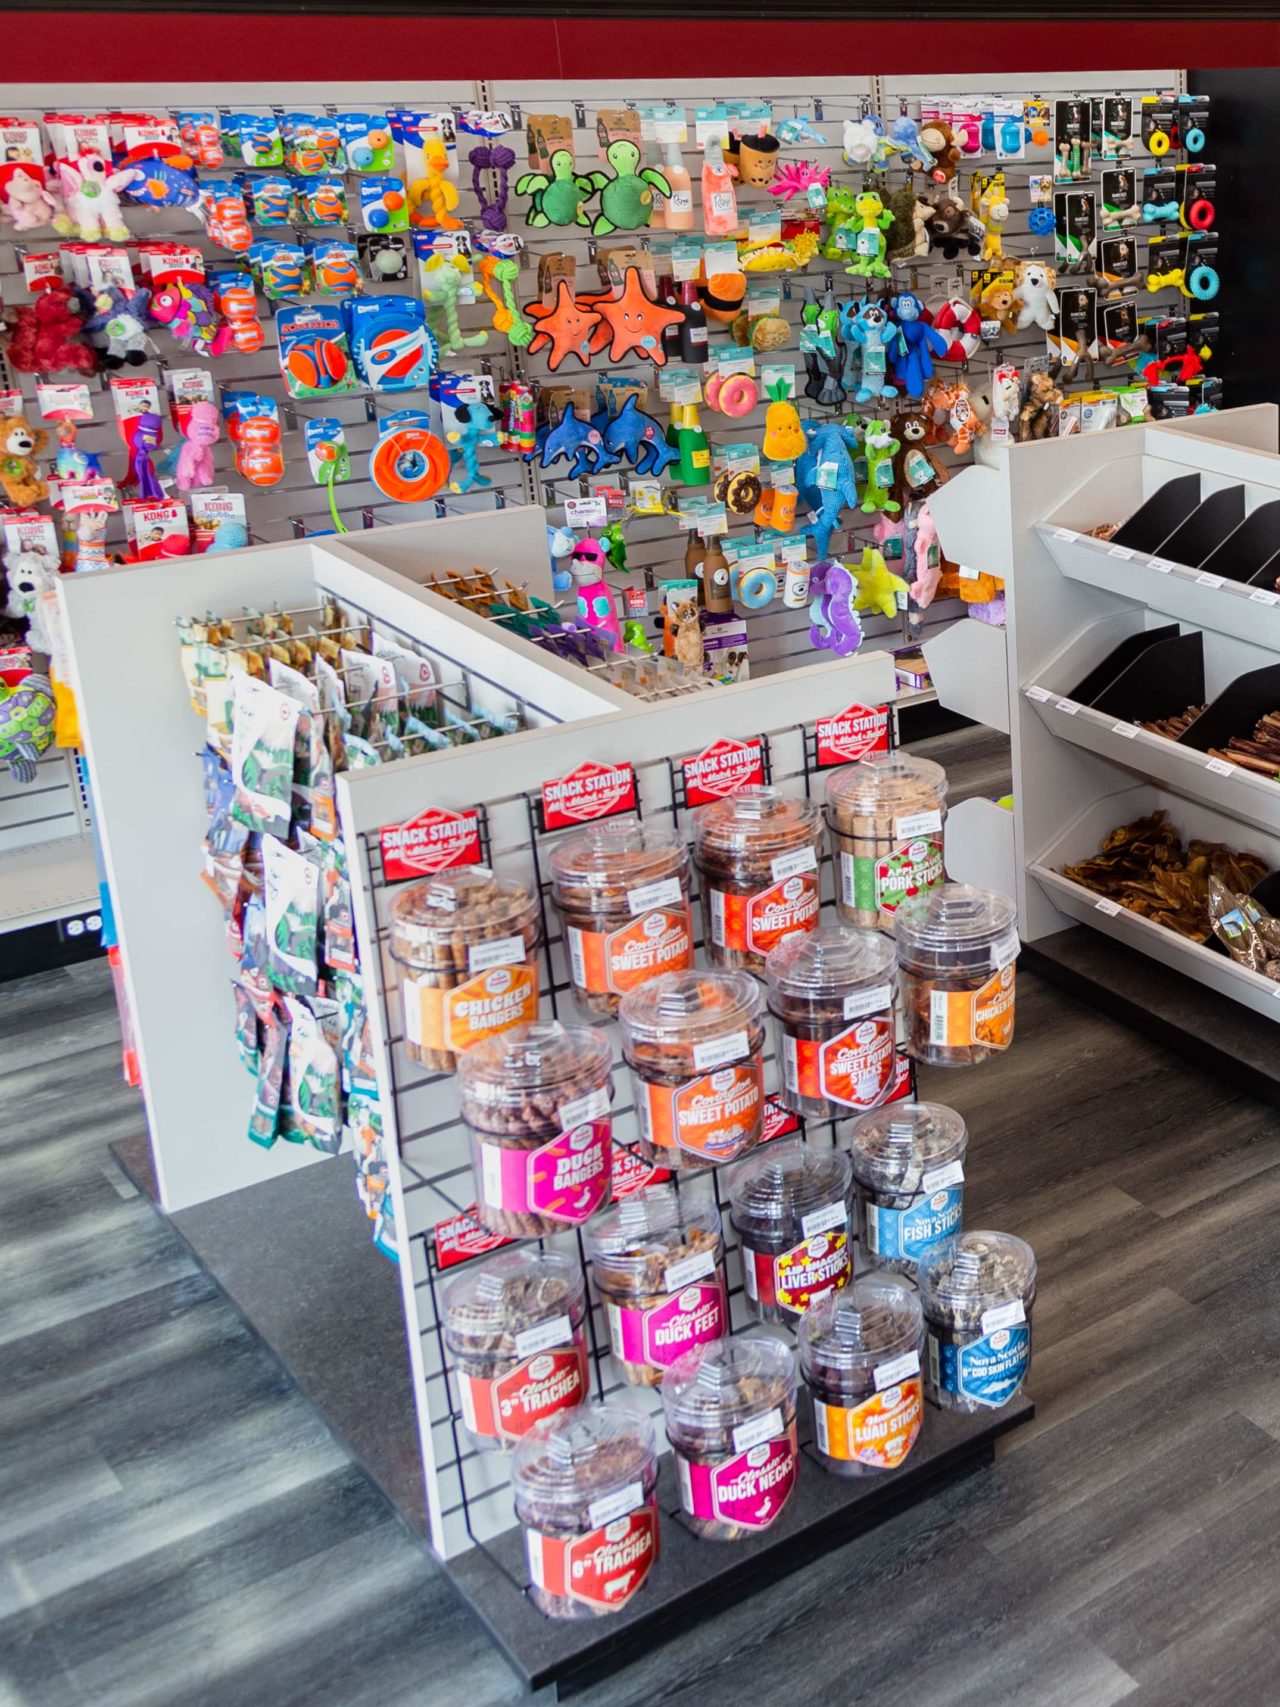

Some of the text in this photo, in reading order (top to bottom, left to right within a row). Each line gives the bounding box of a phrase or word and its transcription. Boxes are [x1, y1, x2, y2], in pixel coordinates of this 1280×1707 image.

[138, 129, 160, 137] KONG
[163, 257, 184, 265] KONG
[143, 511, 170, 521] KONG
[204, 502, 234, 512] KONG
[17, 525, 44, 535] KONG
[818, 711, 888, 737] SNACK STATION
[684, 745, 761, 777] SNACK STATION
[545, 768, 631, 801] SNACK STATION
[383, 817, 477, 848] SNACK STATION
[881, 861, 944, 892] PORK STICKS
[753, 898, 819, 931] SWEET POTATO
[611, 935, 689, 971] SWEET POTATO
[624, 925, 683, 952] Covington
[454, 982, 532, 1018] CHICKEN
[976, 1000, 1007, 1022] CHICKEN
[468, 1003, 524, 1031] BANGERS
[830, 1041, 893, 1075] SWEET POTATO
[850, 1065, 882, 1085] STICKS
[678, 1105, 723, 1126] SWEET
[725, 1086, 759, 1118] POTATO
[691, 1077, 752, 1107] Covington
[556, 1141, 603, 1175] DUCK
[553, 1158, 604, 1191] BANGERS
[904, 1205, 962, 1242] FISH STICKS
[781, 1252, 848, 1289] LIVER STICKS
[786, 1265, 804, 1276] LIP
[655, 1307, 719, 1346] DUCK FEET
[970, 1355, 997, 1367] Nova
[972, 1364, 988, 1378] COD
[988, 1360, 1005, 1375] SKIN
[501, 1368, 580, 1417] 3" TRACHEA
[855, 1401, 920, 1443] LUAU STICKS
[718, 1455, 793, 1503] DUCK NECKS
[594, 1531, 651, 1575] TRACHEA
